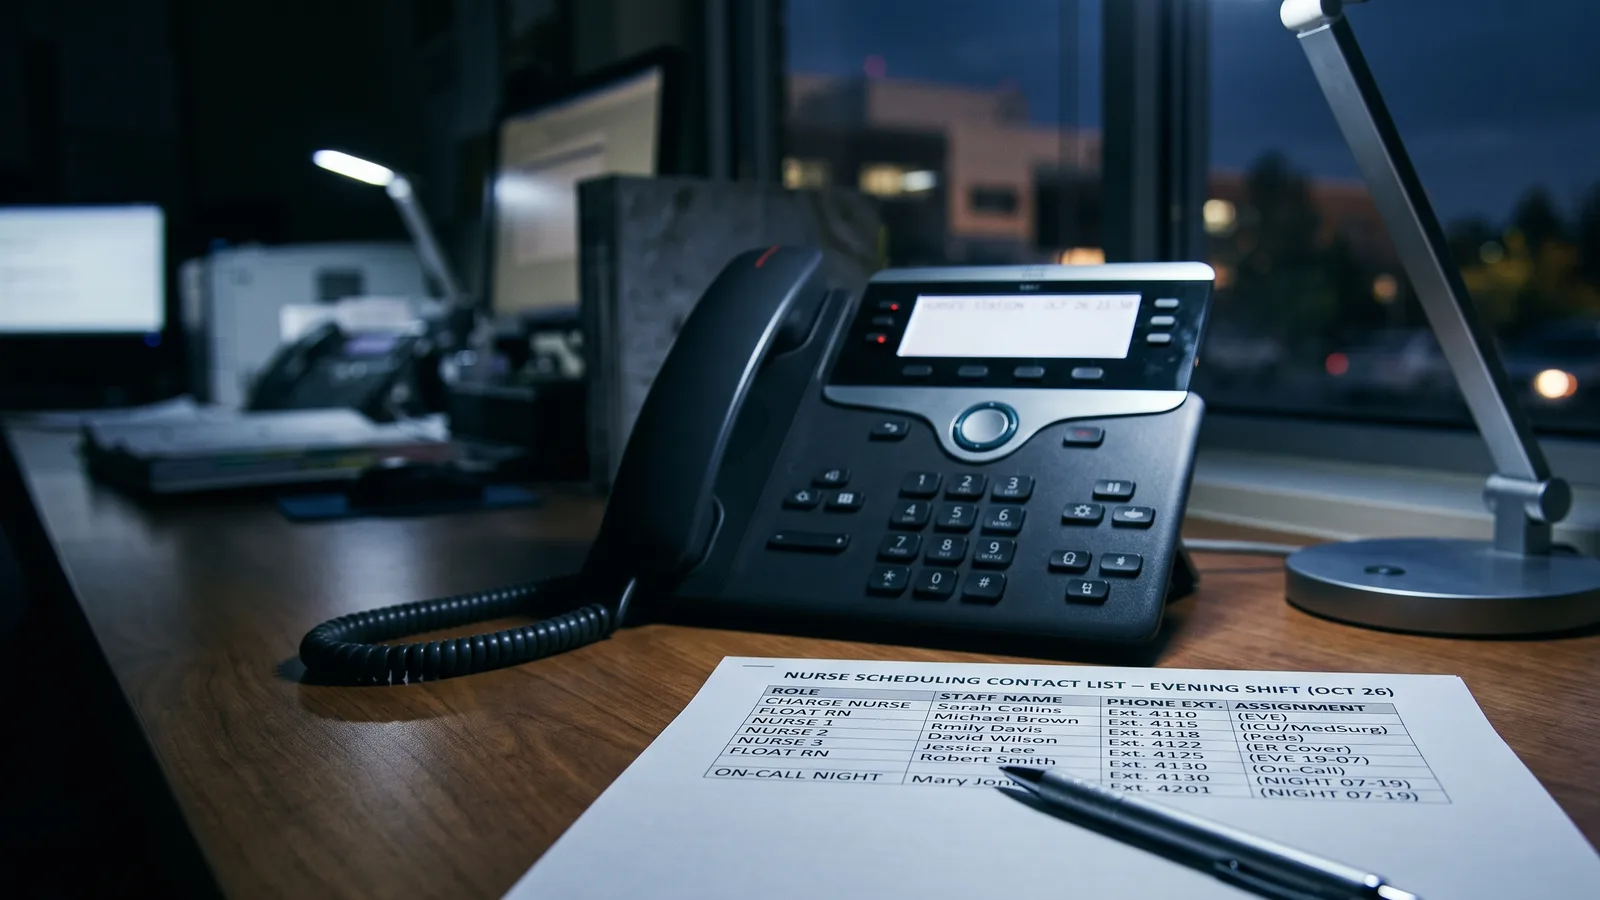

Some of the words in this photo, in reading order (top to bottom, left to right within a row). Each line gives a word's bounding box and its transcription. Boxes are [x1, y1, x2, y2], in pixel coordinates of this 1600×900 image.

[919, 474, 926, 486] 1
[962, 476, 972, 486] 2
[1008, 477, 1018, 489] 3
[906, 504, 916, 516] 4
[952, 506, 963, 518] 5
[998, 509, 1009, 521] 6
[896, 536, 906, 547] 7
[942, 539, 952, 550] 8
[990, 542, 1000, 554] 9
[932, 572, 942, 584] 0
[978, 578, 990, 588] #
[784, 672, 850, 681] NURSE
[854, 674, 981, 685] SCHEDULING
[987, 678, 1081, 688] CONTACT
[1088, 680, 1126, 689] LIST
[1150, 682, 1239, 693] EVENING
[1245, 684, 1300, 694] SHIFT
[1308, 686, 1355, 696] (OCT
[1363, 687, 1395, 698] 26)
[772, 688, 820, 696] ROLE
[765, 698, 843, 707] CHARGE
[848, 700, 912, 709] NURSE
[940, 693, 998, 701] STAFF
[1004, 695, 1063, 704] NAME
[1107, 698, 1176, 708] PHONE
[1182, 700, 1223, 708] EXT.
[937, 703, 992, 712] Sarah
[1235, 702, 1366, 712] ASSIGNMENT
[758, 708, 820, 716] FLOAT
[825, 709, 852, 717] RN
[1149, 710, 1197, 718] 4110
[1238, 713, 1288, 722] (EVE)
[751, 718, 818, 726] NURSE
[934, 714, 1010, 722] Michael
[1017, 716, 1079, 724] Brown
[1150, 720, 1198, 728] 4115
[745, 727, 814, 736] NURSE
[990, 725, 1042, 734] Davis
[1240, 722, 1388, 735] (ICU/MedSurg)
[928, 733, 984, 742] David
[990, 735, 1058, 744] Wilson
[1151, 730, 1200, 738] 4118
[1243, 733, 1304, 742] (Peds)
[738, 736, 806, 746] NURSE
[1109, 739, 1145, 747] Ext.
[1152, 740, 1202, 748] 4122
[729, 748, 796, 756] FLOAT
[800, 750, 830, 758] RN
[922, 744, 993, 752] Jessica
[1000, 746, 1036, 754] Lee
[1246, 744, 1278, 752] (ER
[1284, 745, 1352, 754] Cover)
[920, 754, 990, 764] Robert
[996, 756, 1056, 766] Smith
[1109, 750, 1146, 758] Ext.
[1153, 751, 1204, 760] 4125
[1250, 754, 1296, 763] (EVE
[1303, 756, 1370, 766] 19-07)
[1110, 760, 1146, 768] Ext.
[1154, 762, 1208, 770] 4130
[714, 768, 806, 779] ON-CALL
[812, 772, 883, 782] NIGHT
[1252, 765, 1346, 776] (On-Call)
[912, 776, 968, 786] Mary
[1110, 772, 1148, 780] Ext.
[1156, 773, 1210, 782] 4130
[1256, 776, 1333, 786] (NIGHT
[1340, 779, 1411, 790] 07-19)
[1110, 783, 1150, 792] Ext.
[1157, 784, 1212, 794] 4201
[1260, 788, 1338, 799] (NIGHT
[1346, 791, 1418, 802] 07-19)
